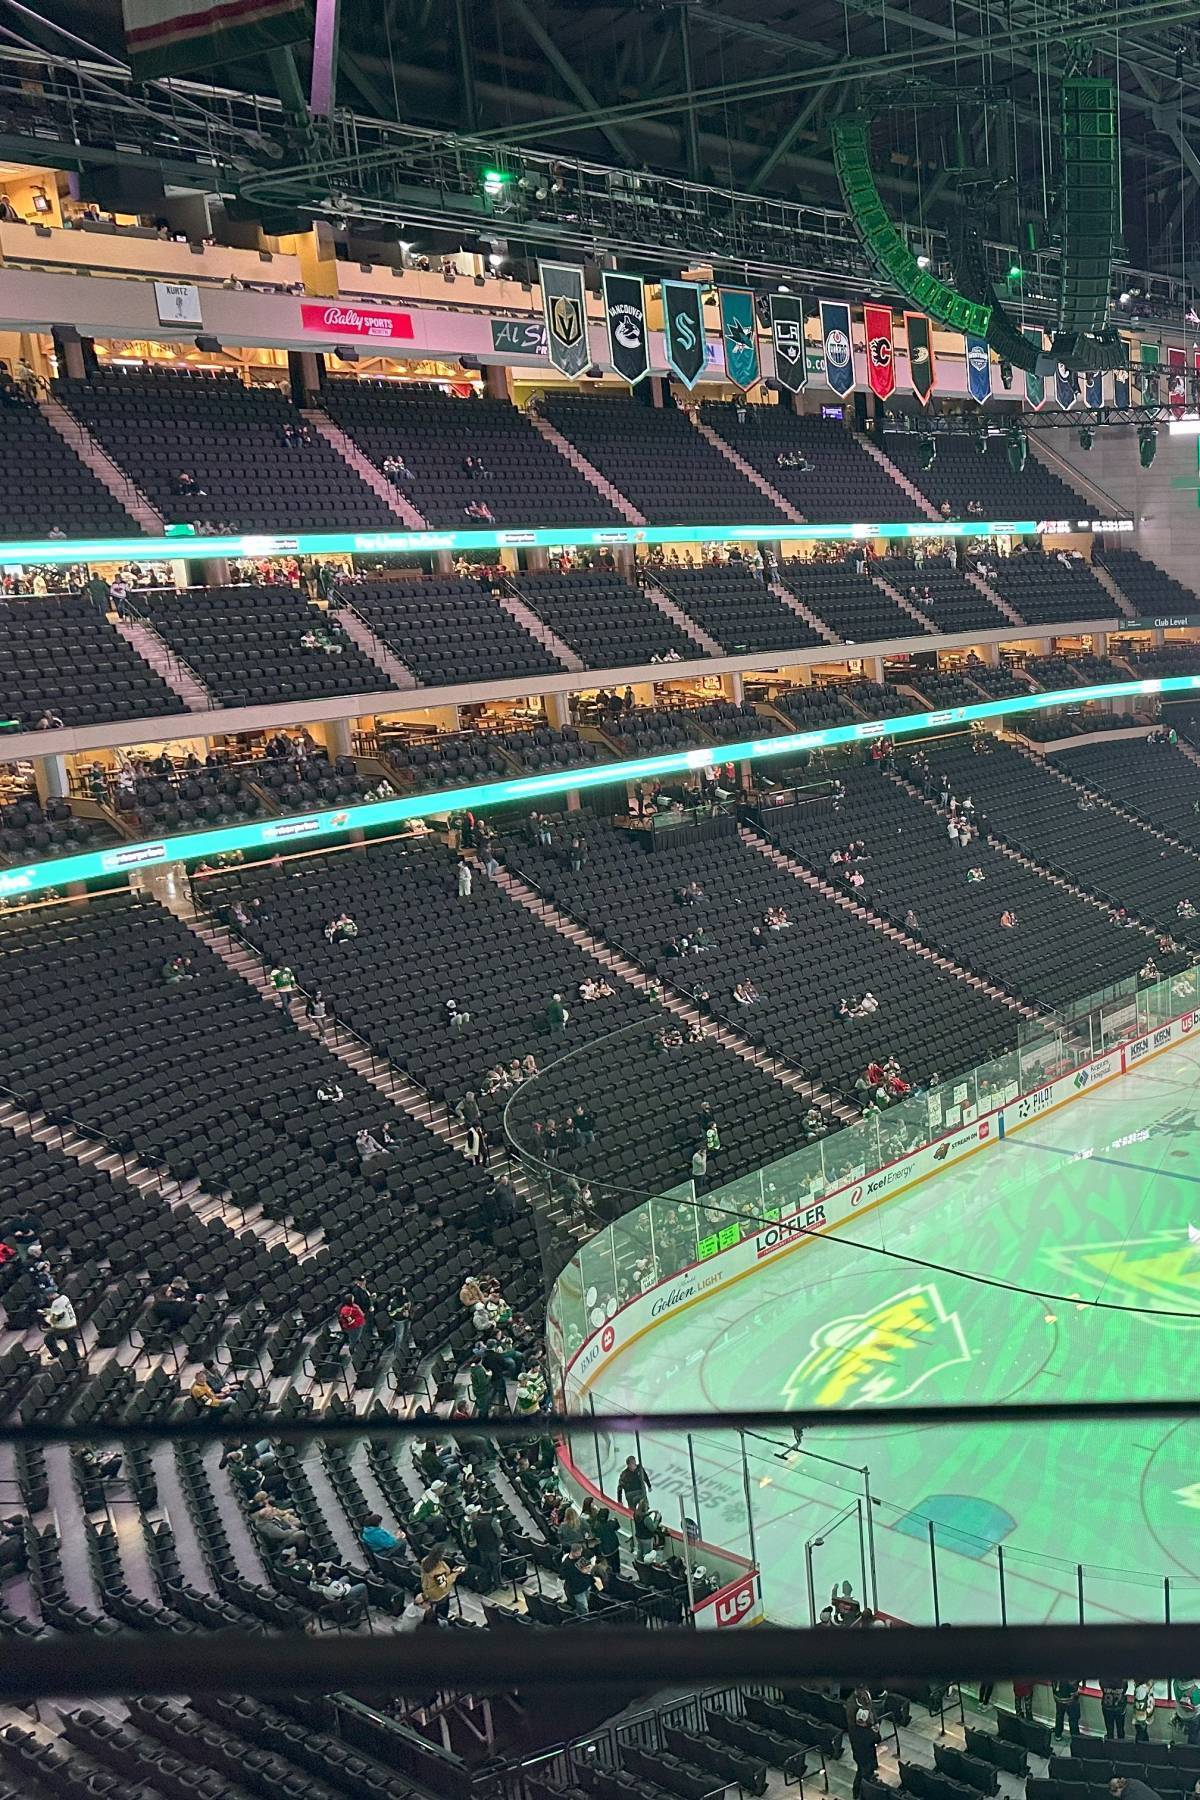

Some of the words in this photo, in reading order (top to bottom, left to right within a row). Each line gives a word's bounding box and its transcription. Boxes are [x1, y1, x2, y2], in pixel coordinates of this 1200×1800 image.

[166, 286, 188, 296] KURTZ
[323, 307, 364, 330] Bally
[364, 317, 393, 329] SPORTS
[608, 303, 643, 322] VANCOUVER
[1154, 618, 1169, 627] Club
[1170, 618, 1188, 626] Level
[1033, 1086, 1053, 1106] PILOT
[951, 1136, 970, 1150] STREAM
[970, 1132, 978, 1141] ON
[756, 1204, 826, 1252] LOFFLER
[651, 1286, 695, 1317] Golden
[697, 1271, 723, 1292] LIGHT
[580, 1345, 599, 1374] BMO
